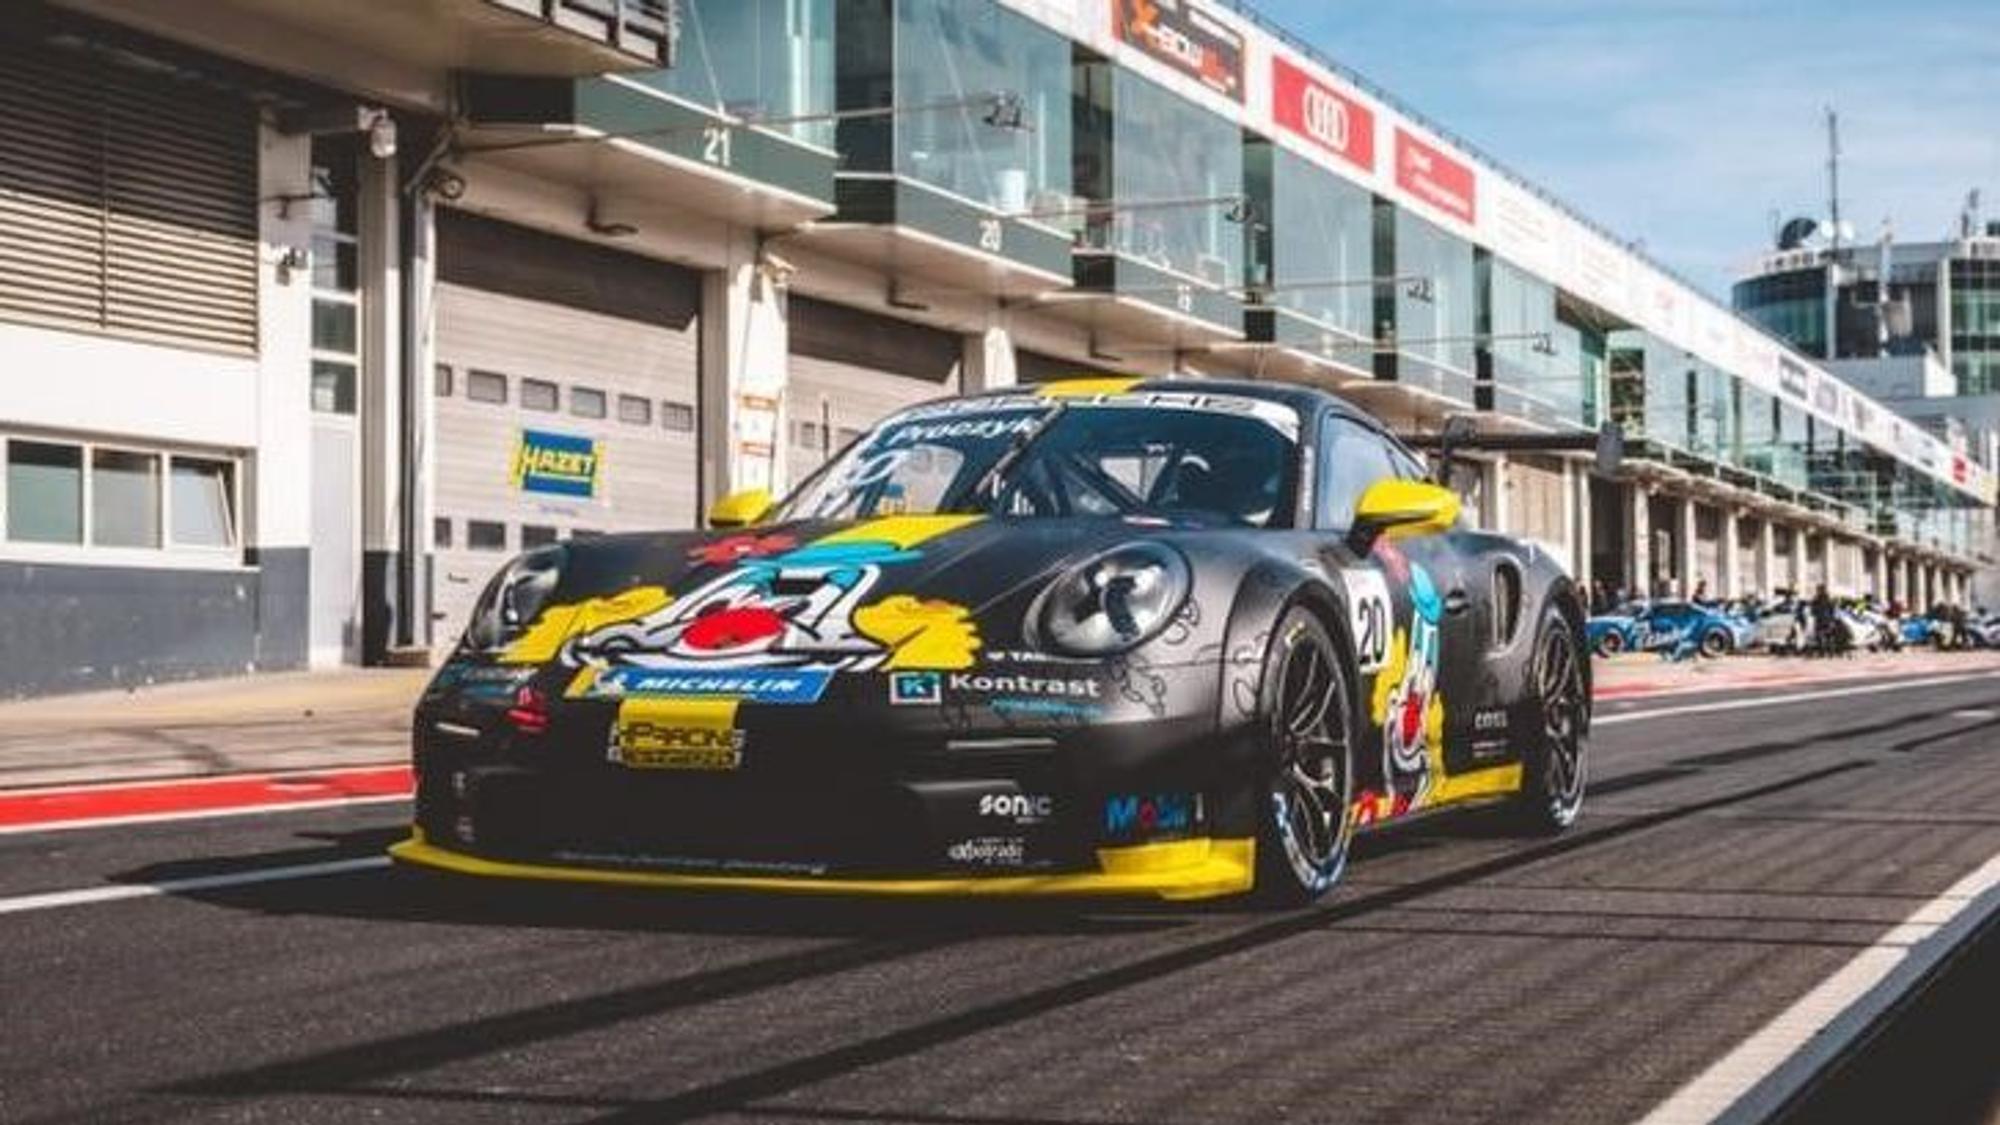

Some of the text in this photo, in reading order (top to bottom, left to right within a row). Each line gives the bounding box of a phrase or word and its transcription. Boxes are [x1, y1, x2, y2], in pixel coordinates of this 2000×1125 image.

[704, 127, 732, 167] 21
[518, 444, 596, 477] HAZET
[1359, 596, 1387, 664] 20
[636, 677, 802, 692] MICHELIN
[951, 672, 1101, 697] Kontrast
[1106, 794, 1190, 832] Mobil
